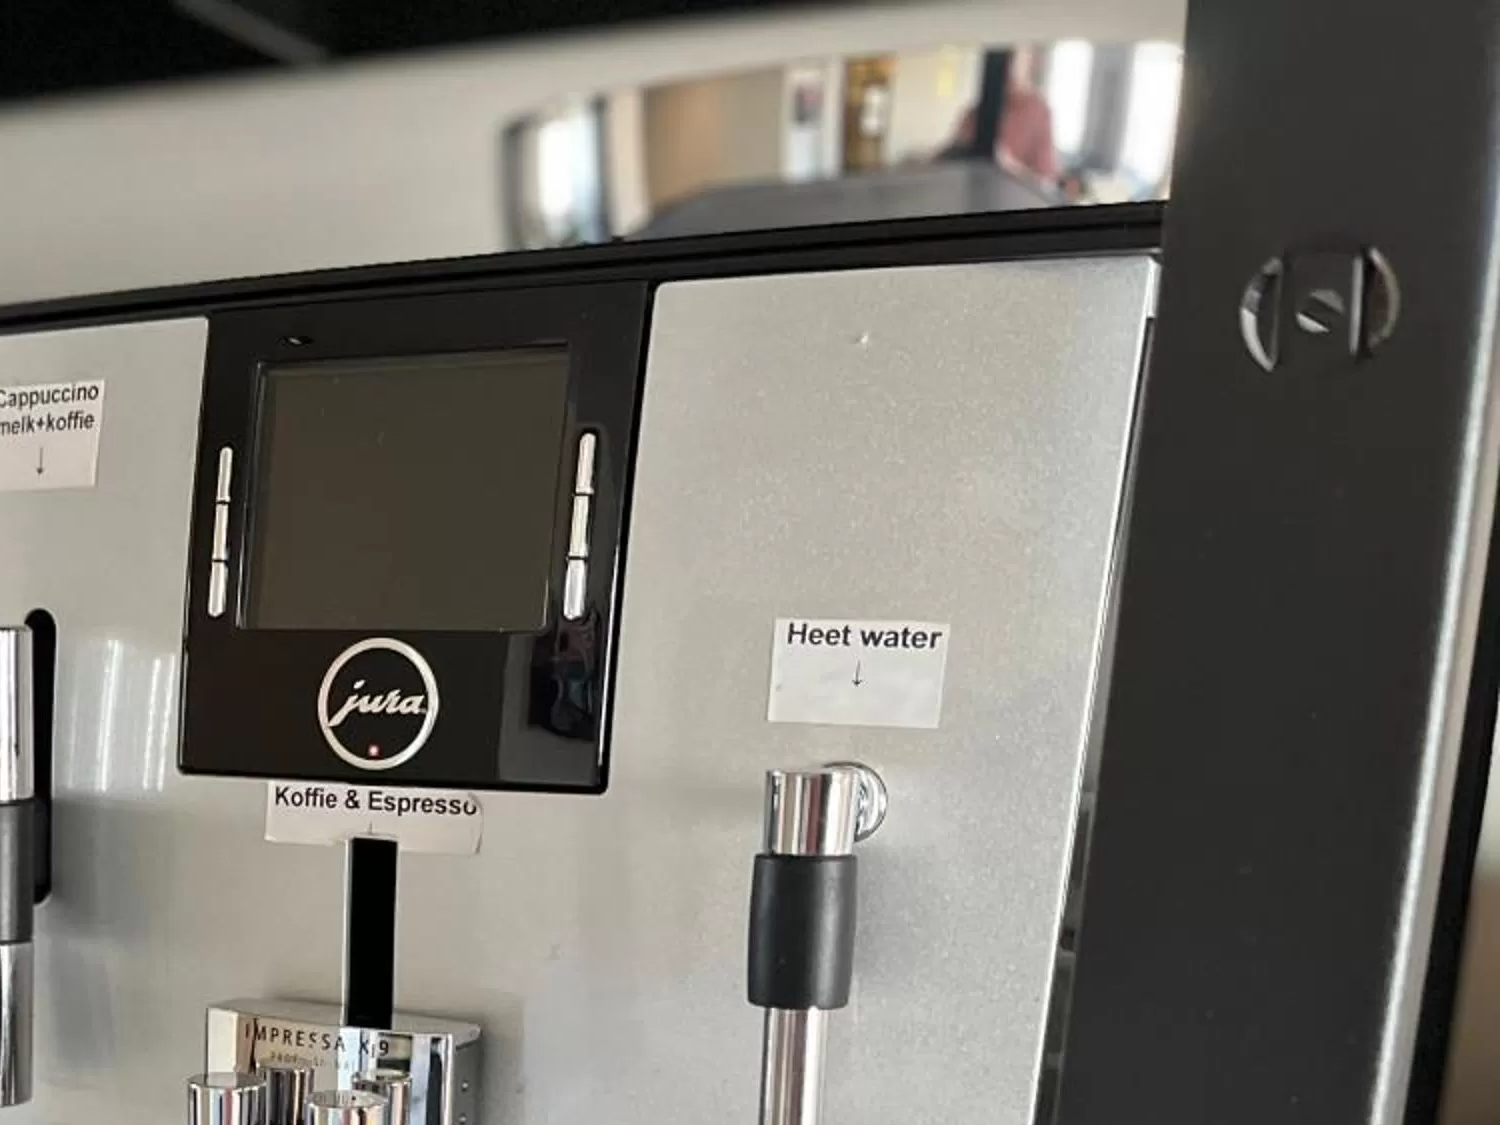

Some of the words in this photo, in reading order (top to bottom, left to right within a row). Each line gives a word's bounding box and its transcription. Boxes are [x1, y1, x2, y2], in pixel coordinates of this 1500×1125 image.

[787, 622, 851, 646] Heet
[860, 627, 942, 649] water
[327, 679, 424, 727] jura
[275, 786, 337, 809] Koffie
[345, 789, 360, 809] &
[368, 791, 477, 816] Espresso
[245, 1023, 346, 1053] IMPRESSA
